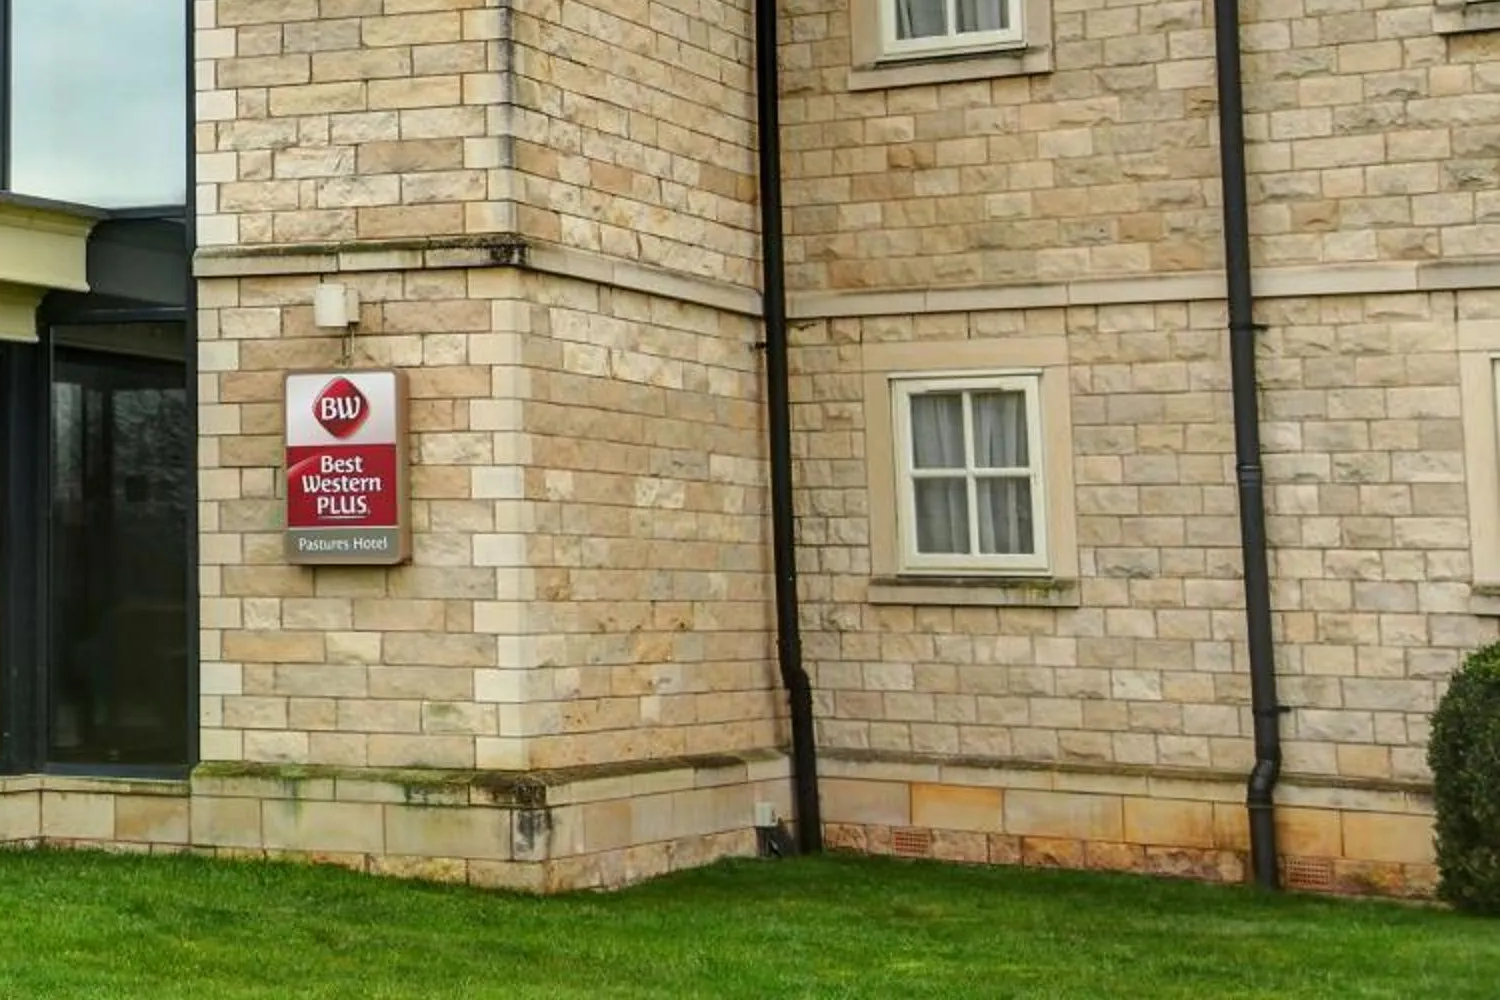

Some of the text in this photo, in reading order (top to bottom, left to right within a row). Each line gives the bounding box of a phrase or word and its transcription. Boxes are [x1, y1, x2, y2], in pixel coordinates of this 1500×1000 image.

[321, 397, 360, 420] BW
[321, 456, 363, 472] Best
[302, 476, 381, 493] Western
[317, 496, 368, 515] PLUS
[299, 536, 388, 550] Pastures Hotel
